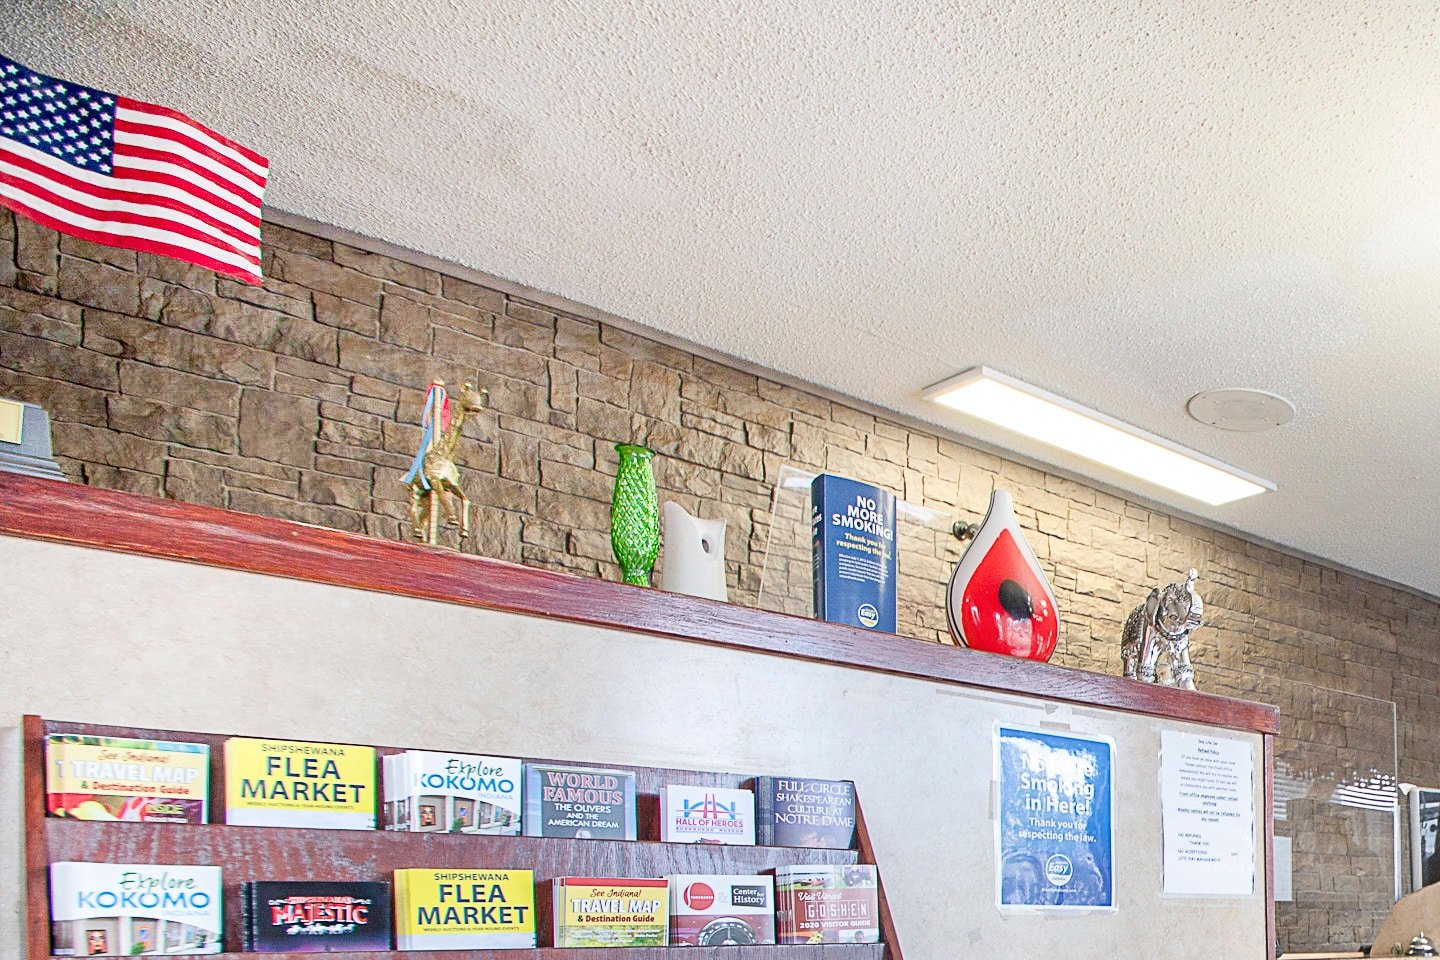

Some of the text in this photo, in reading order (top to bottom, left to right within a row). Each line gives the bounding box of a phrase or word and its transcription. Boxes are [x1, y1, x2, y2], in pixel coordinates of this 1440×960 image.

[856, 496, 876, 510] NO
[848, 505, 884, 526] MORE
[832, 514, 894, 541] SMOKING!
[845, 533, 866, 544] Thank
[836, 540, 872, 554] respecting
[262, 744, 346, 756] SHIPSHEWANA
[72, 760, 145, 781] TRAVEL
[150, 766, 198, 784] MAP
[267, 756, 341, 780] FLEA
[446, 758, 504, 779] Explore
[414, 773, 514, 794] KOKOMO
[546, 771, 618, 788] WORLD
[93, 781, 190, 794] Destination Guide
[240, 778, 365, 804] MARKET
[810, 782, 851, 796] CIRCLE
[543, 786, 623, 805] FAMOUS
[776, 793, 852, 806] SHAKESPEAREAN
[554, 803, 612, 815] THE OLIVERS
[787, 805, 829, 816] CULTURE
[1026, 793, 1091, 816] in Here!
[566, 812, 583, 820] AND
[676, 818, 744, 828] HALL OF HEROES
[775, 812, 854, 828] NOTRE DAME
[548, 818, 619, 830] AMERICAN DREAM
[1030, 817, 1087, 830] Thank you for
[1018, 830, 1097, 842] respecting the law.
[1049, 863, 1068, 874] Easy
[120, 871, 196, 896] Explore
[434, 872, 510, 881] SHIPSHEWANA
[438, 883, 507, 903] FLEA
[734, 888, 758, 896] Center
[78, 891, 210, 909] KOKOMO
[571, 898, 662, 914] TRAVEL MAP
[734, 895, 766, 905] History
[272, 903, 368, 926] MAJESTIC
[418, 906, 528, 925] MARKET
[586, 914, 655, 922] Destination Guide
[822, 920, 850, 928] VISITOR
